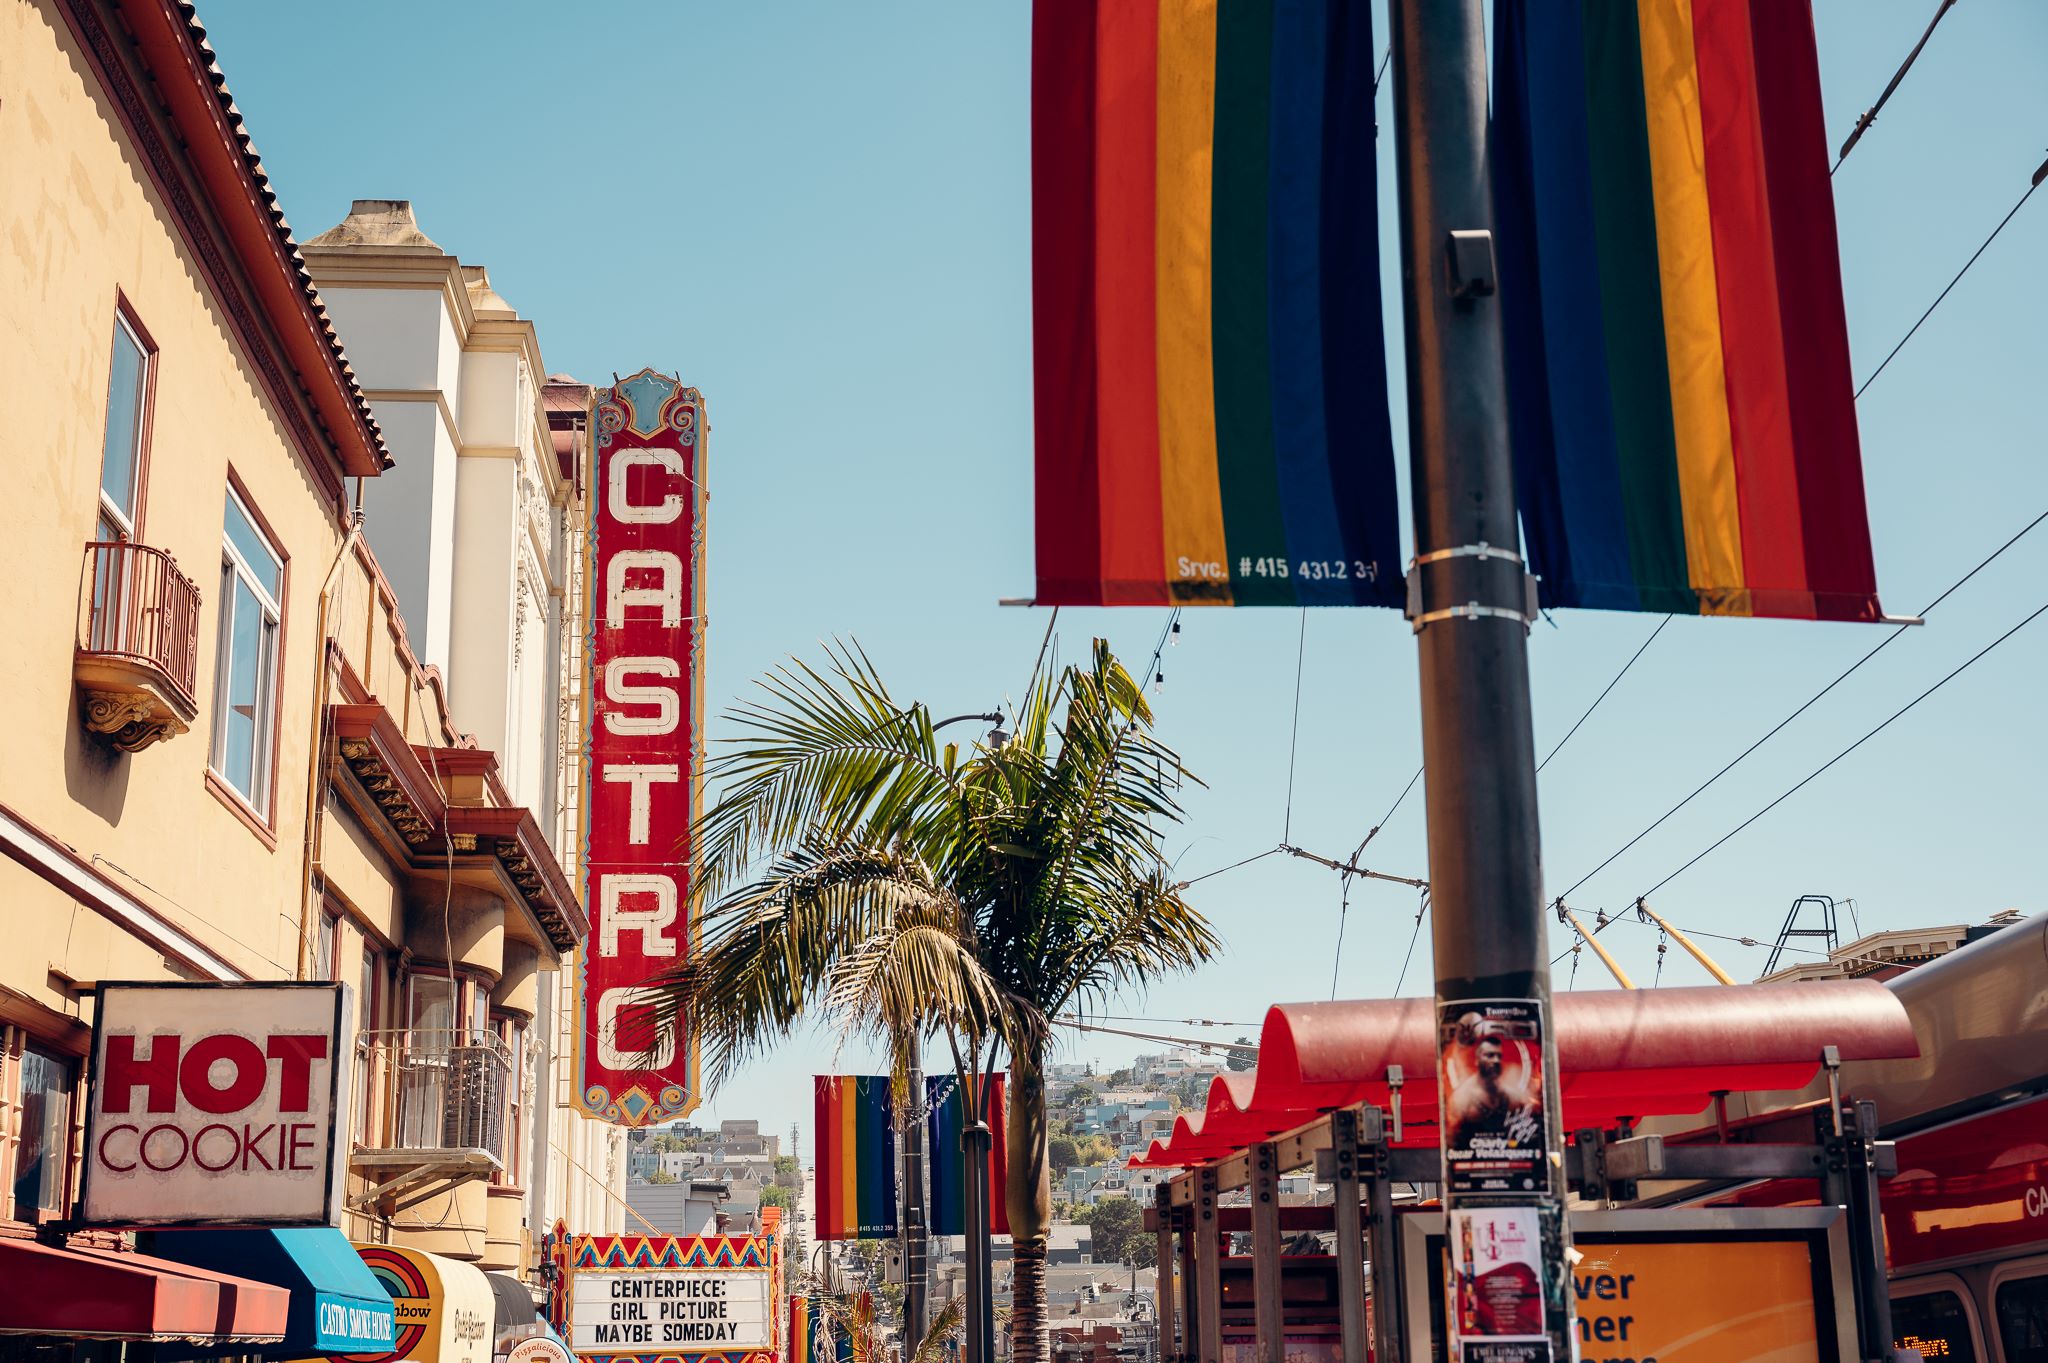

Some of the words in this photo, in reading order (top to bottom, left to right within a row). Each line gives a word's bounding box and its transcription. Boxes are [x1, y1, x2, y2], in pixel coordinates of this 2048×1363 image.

[1178, 556, 1227, 578] Srvc.
[1239, 557, 1289, 578] #415
[1299, 561, 1347, 579] 431.2
[597, 448, 684, 1070] CASTRO
[102, 1034, 327, 1113] HOT
[98, 1123, 316, 1172] COOKIE
[611, 1280, 727, 1298] CENTERPIECE:
[320, 1302, 348, 1338] CASTRO
[349, 1304, 371, 1339] SMOKE
[371, 1306, 392, 1341] HOUSE
[611, 1302, 648, 1320] GIRL
[660, 1301, 728, 1319] PICTURE
[595, 1324, 652, 1343] MAYBE
[663, 1322, 738, 1342] SOMEDAY
[514, 1343, 562, 1361] Pizzalicious
